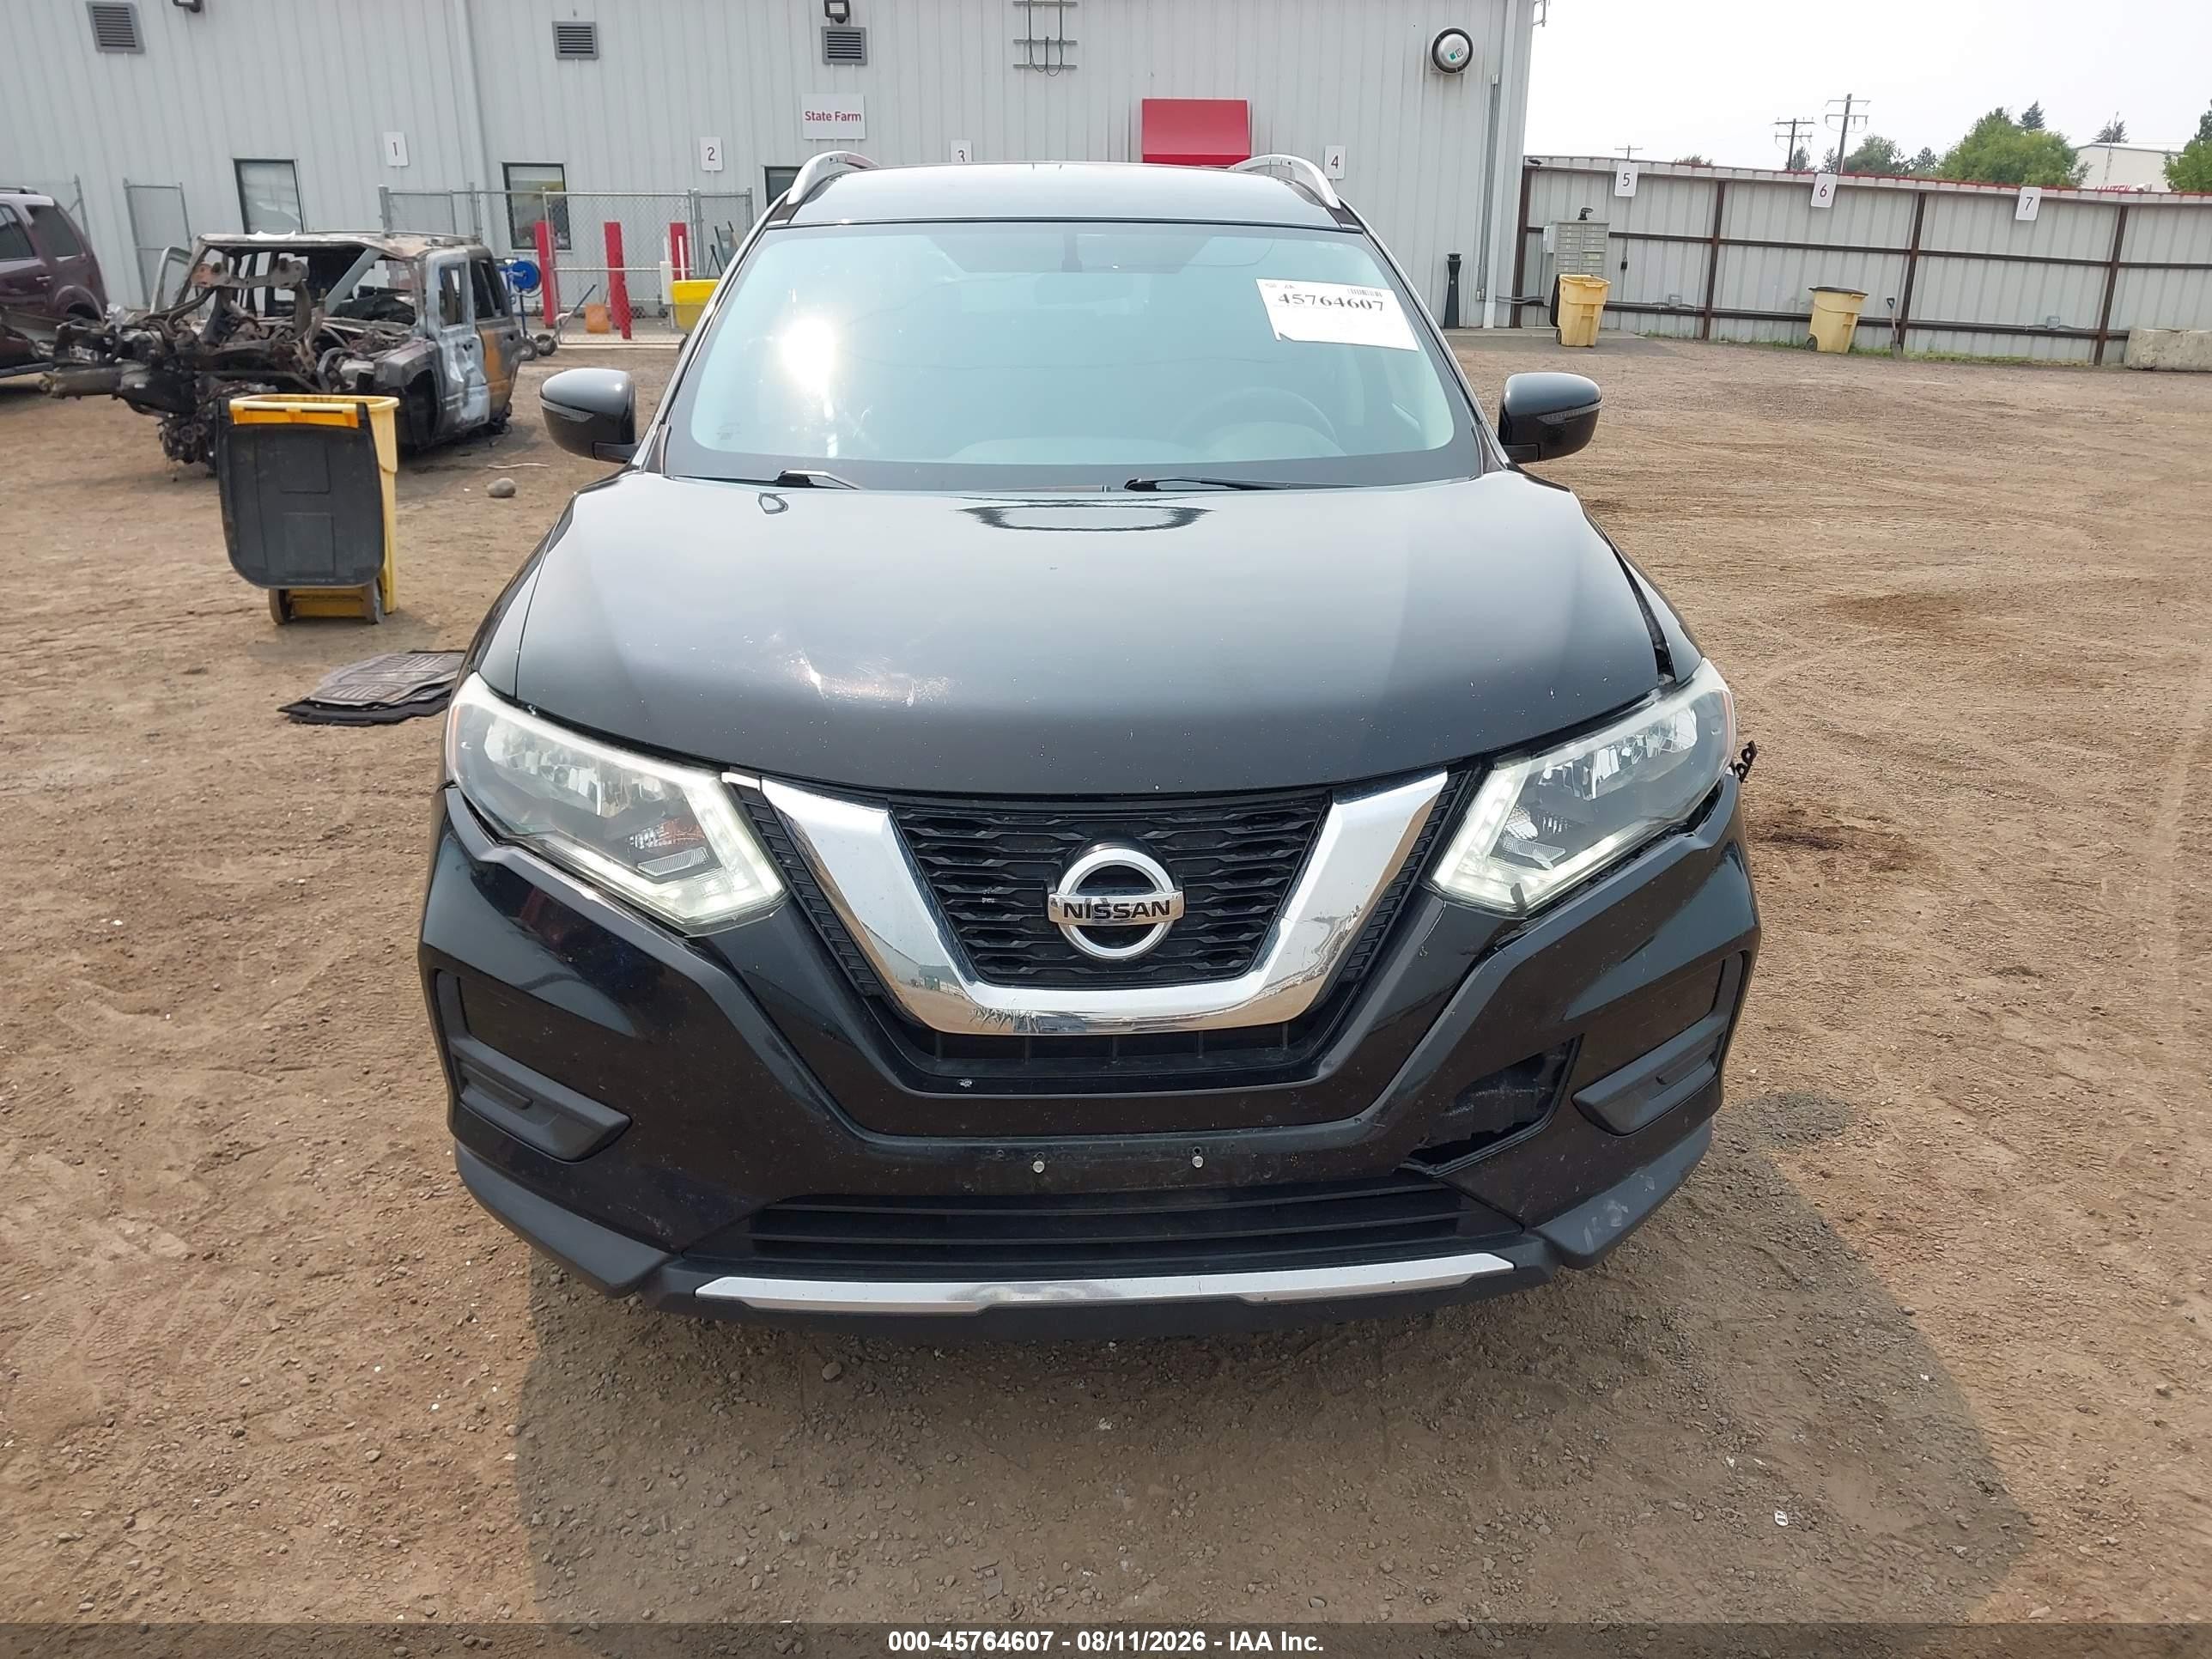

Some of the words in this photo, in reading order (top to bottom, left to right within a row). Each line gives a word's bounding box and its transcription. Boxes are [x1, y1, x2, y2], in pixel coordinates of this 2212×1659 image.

[805, 111, 832, 122] State
[835, 111, 861, 122] Farm
[392, 141, 398, 156] 1
[707, 146, 715, 161] 2
[957, 149, 965, 162] 3
[1330, 155, 1339, 169] 4
[1622, 173, 1631, 187] 5
[1819, 184, 1827, 198] 6
[2025, 196, 2034, 211] 7
[1278, 293, 1383, 312] 45764607
[1063, 899, 1170, 920] NISSAN
